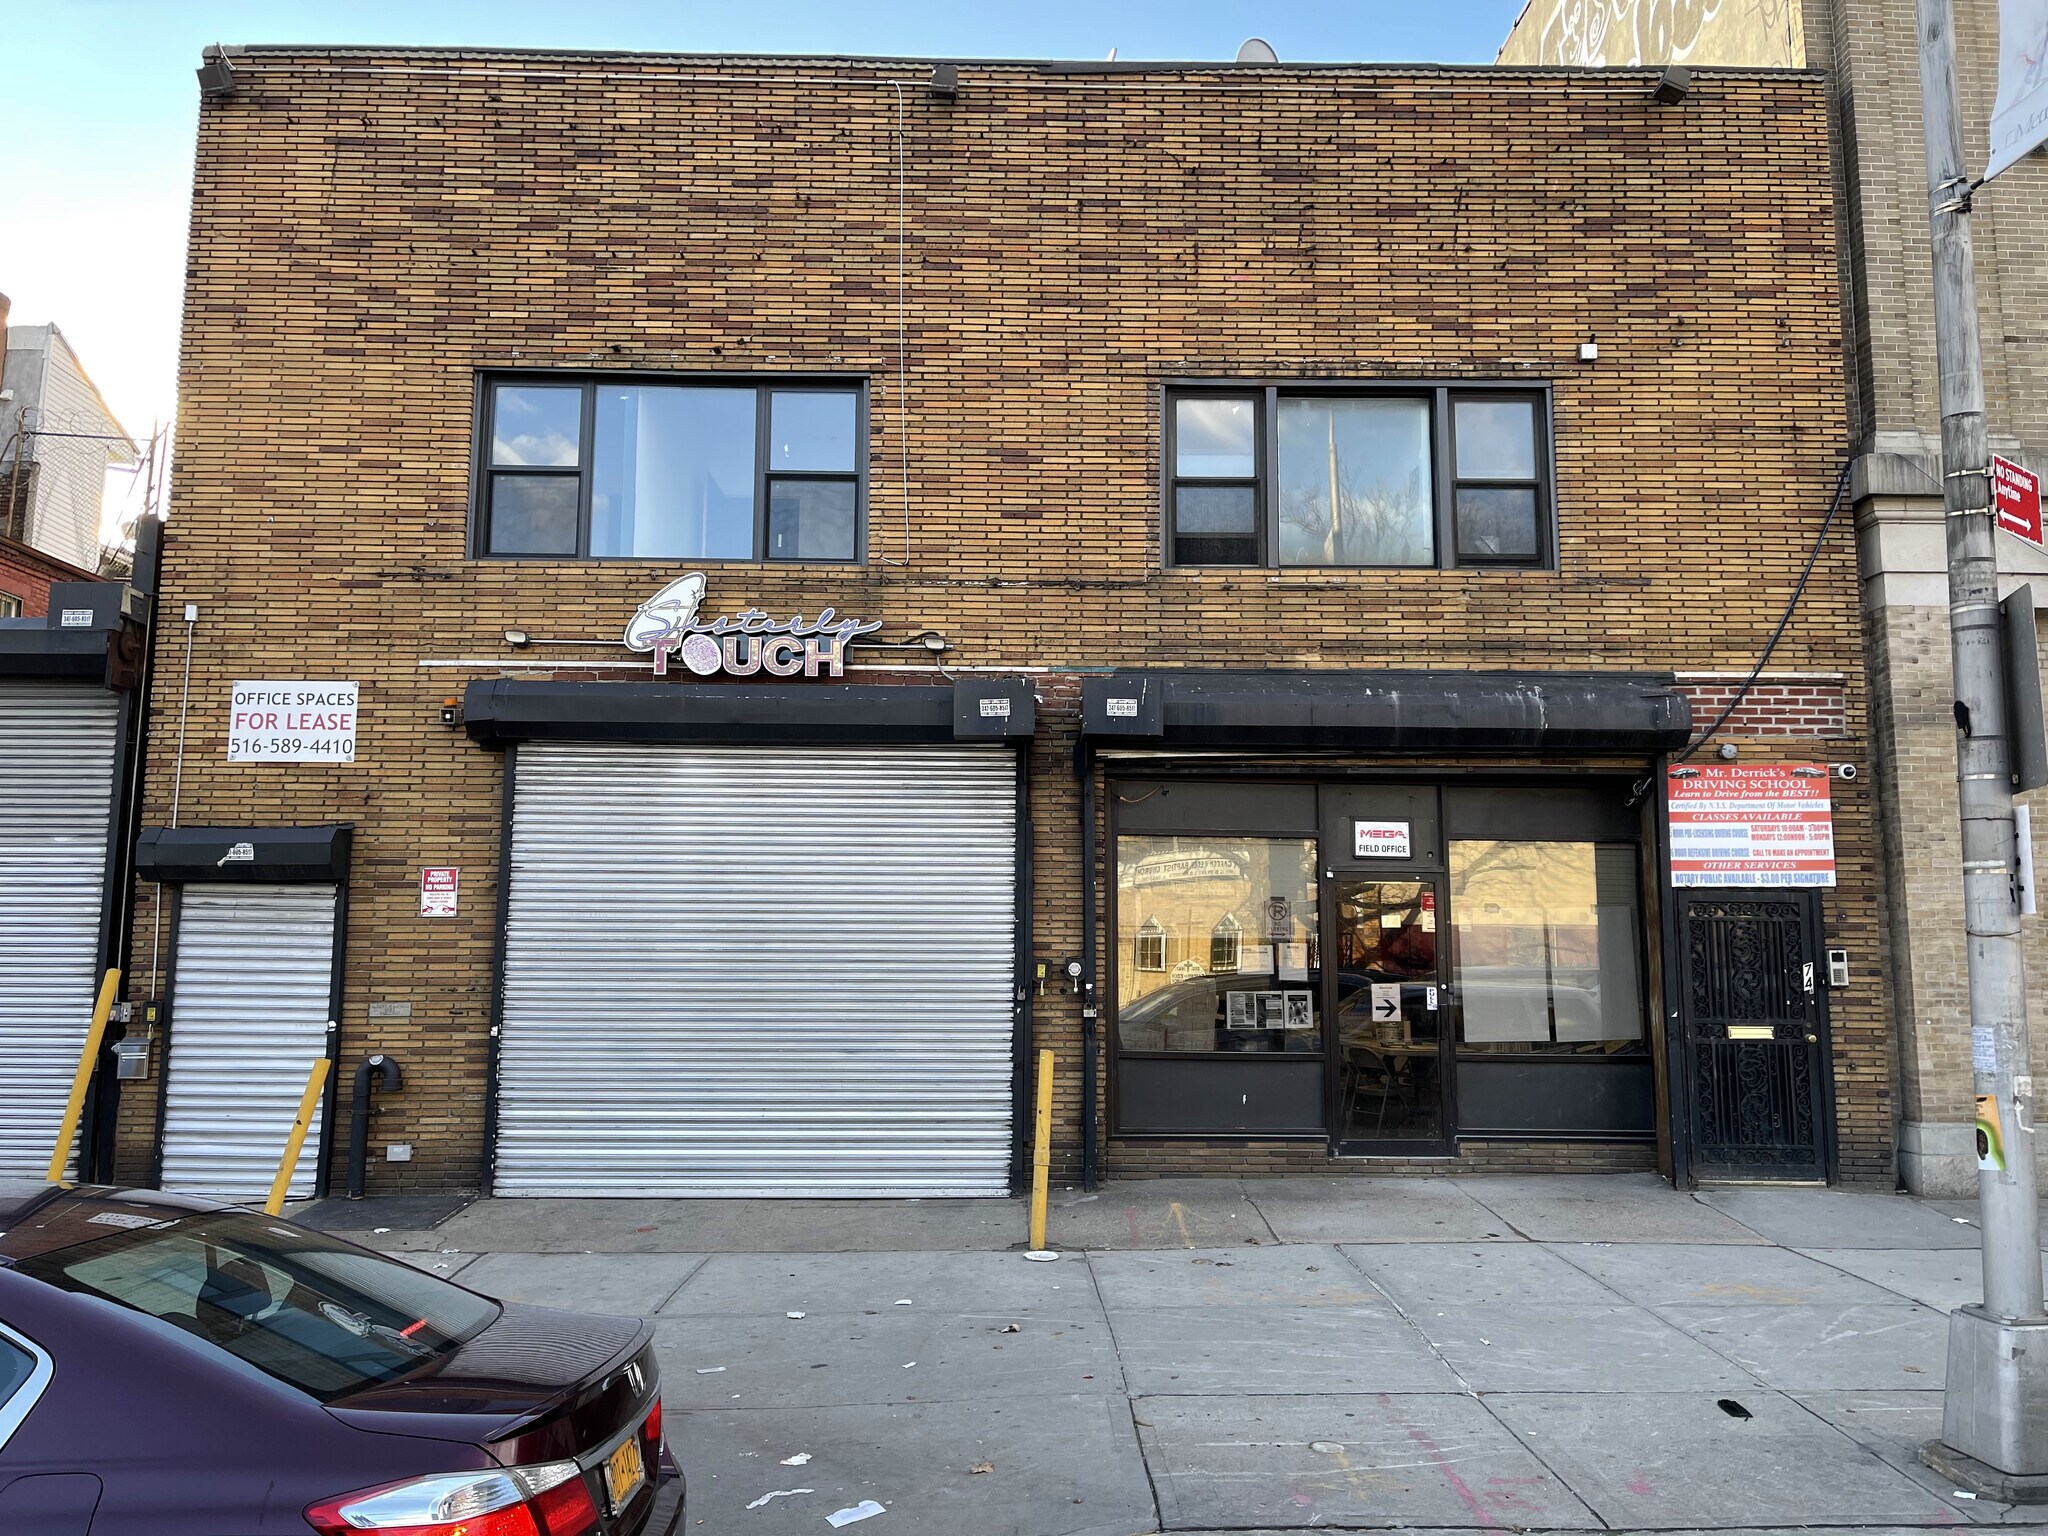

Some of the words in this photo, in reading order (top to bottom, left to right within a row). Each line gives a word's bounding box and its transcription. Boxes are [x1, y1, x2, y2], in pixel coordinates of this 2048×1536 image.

[1996, 463, 2005, 479] NO
[2005, 468, 2033, 492] STANDING
[1997, 480, 2021, 502] Anytime
[637, 600, 880, 642] Sisterly
[653, 633, 843, 677] TOUCH
[235, 692, 291, 705] OFFICE
[296, 693, 355, 706] SPACES
[235, 713, 278, 730] FOR
[286, 713, 352, 731] LEASE
[231, 738, 353, 754] 516-589-4410
[1705, 768, 1727, 778] Mr.
[1731, 768, 1786, 778] Derrick's
[1683, 780, 1746, 789] DRIVING
[1749, 779, 1811, 789] SCHOOL
[1674, 790, 1700, 798] Learn
[1702, 790, 1712, 798] to
[1714, 790, 1739, 798] Drive
[1740, 789, 1763, 799] from
[1765, 789, 1779, 797] the
[1782, 789, 1819, 797] BEST!!
[1671, 801, 1697, 810] Certified
[1699, 802, 1707, 810] By
[1729, 801, 1765, 810] Department
[1767, 801, 1775, 810] Of
[1777, 801, 1796, 809] Motor
[1798, 801, 1824, 809] Vehicles
[1692, 813, 1739, 821] CLASSES
[1740, 813, 1802, 821] AVAILABLE
[1360, 830, 1407, 839] MEGA
[1673, 829, 1684, 838] HOUR
[1715, 829, 1731, 838] DRIVING
[1732, 829, 1748, 838] COURSE
[1751, 833, 1776, 841] MONDAYS
[1382, 845, 1406, 853] OFFICE
[1675, 848, 1687, 857] HOUR
[1688, 848, 1711, 857] DEFENSIVE
[1712, 848, 1730, 857] DRIVING
[1732, 848, 1749, 857] COURSE
[1675, 873, 1699, 885] NOTARY
[1700, 873, 1722, 883] PUBLIC
[1724, 873, 1755, 883] AVAILABLE
[1761, 873, 1779, 884] $3.00
[1781, 873, 1792, 884] PER
[1794, 873, 1829, 884] SIGNATURE
